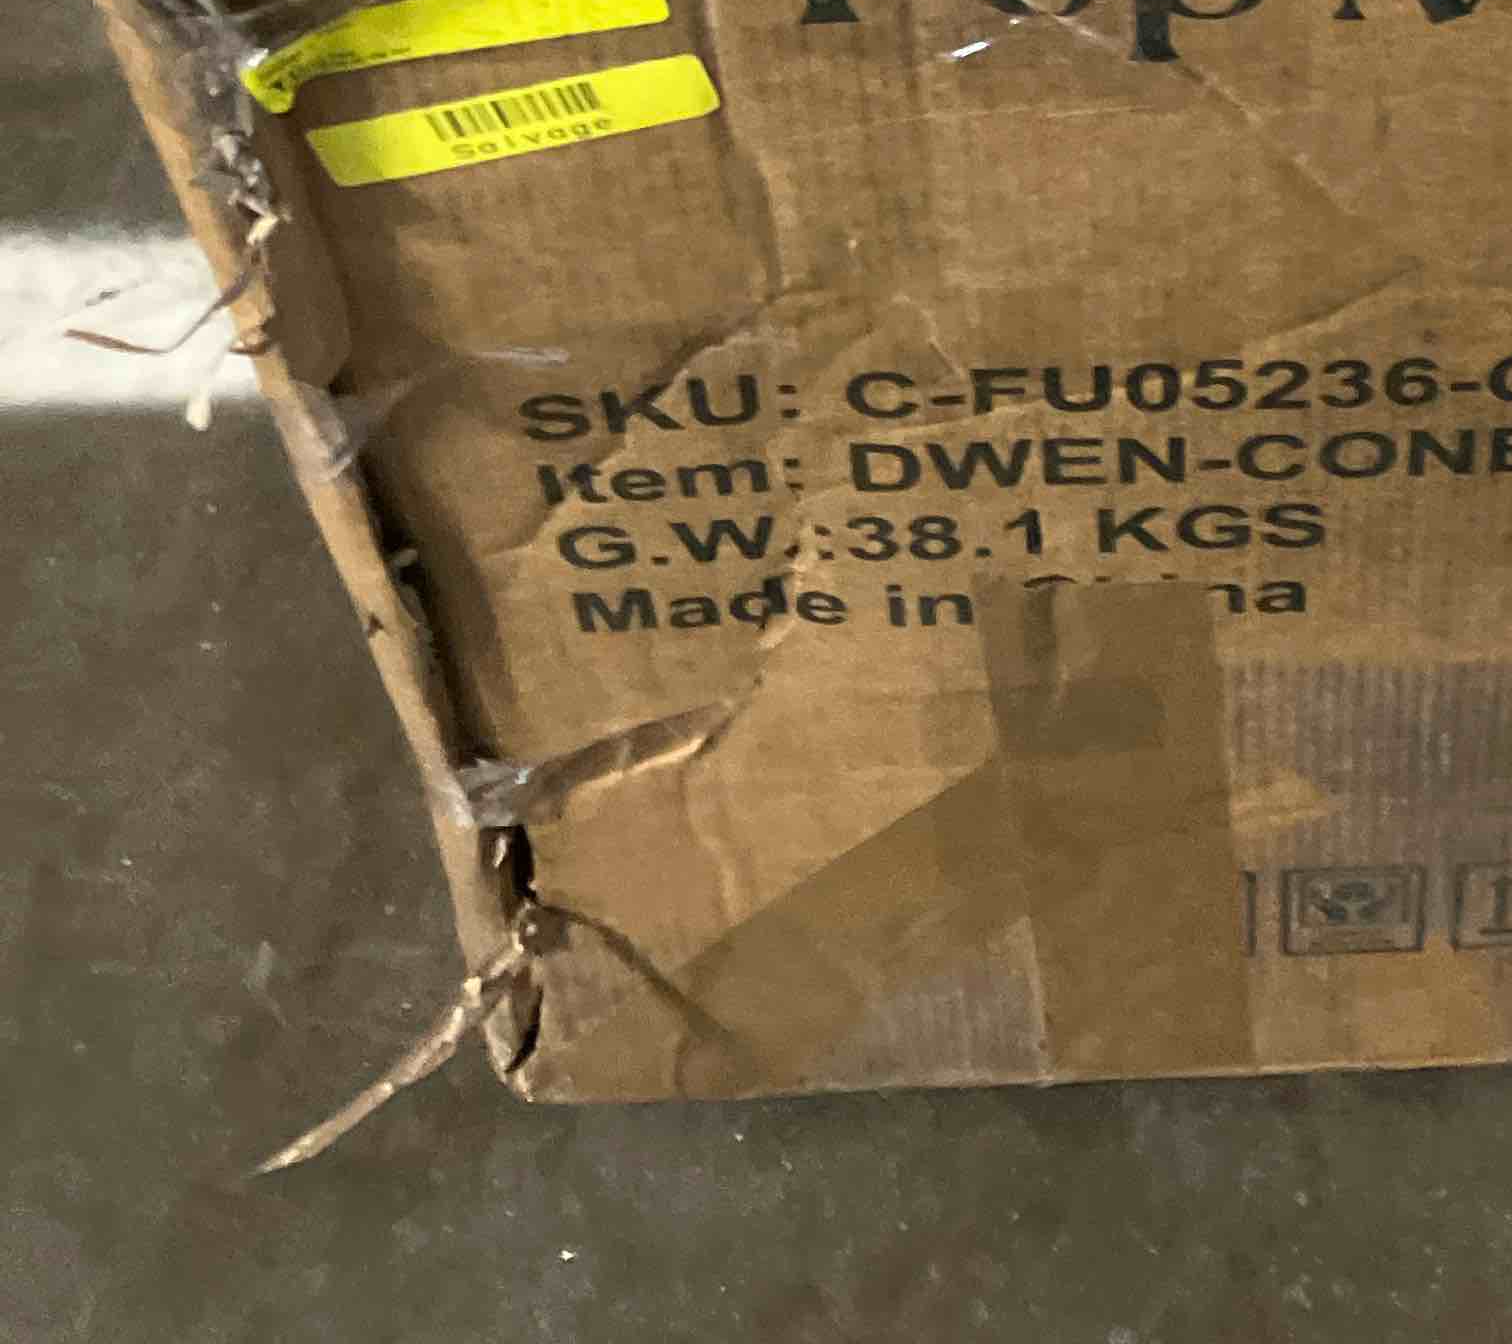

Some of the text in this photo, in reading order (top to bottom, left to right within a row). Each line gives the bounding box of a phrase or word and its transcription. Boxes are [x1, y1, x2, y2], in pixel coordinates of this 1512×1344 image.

[451, 116, 612, 160] Salvage
[518, 374, 801, 441] SKU:
[537, 458, 805, 507] Item:
[1098, 502, 1327, 553] KGS
[571, 575, 849, 634] Made
[885, 583, 974, 627] in
